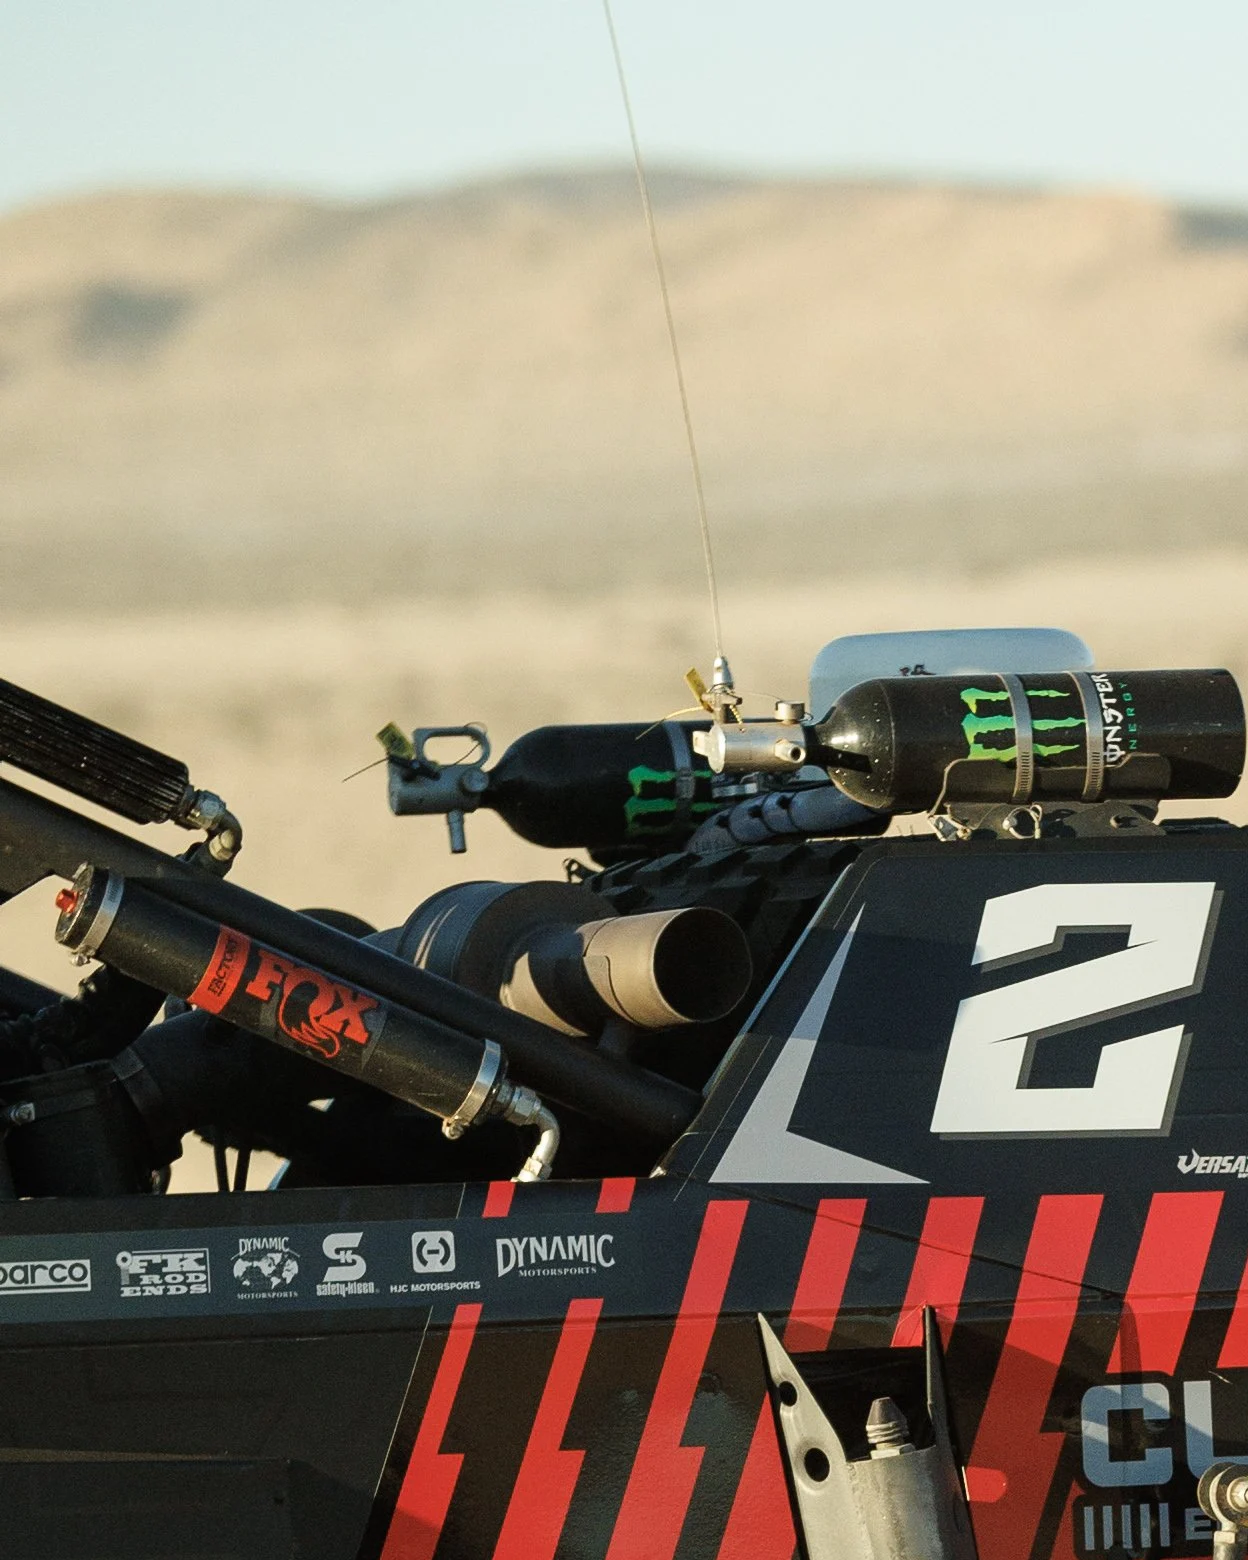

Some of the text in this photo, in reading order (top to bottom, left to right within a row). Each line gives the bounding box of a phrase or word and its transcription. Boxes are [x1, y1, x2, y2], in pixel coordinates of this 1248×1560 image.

[1091, 673, 1125, 764] ONSTER
[246, 948, 379, 1058] FOX
[931, 881, 1222, 1136] 2
[238, 1236, 290, 1256] DYNAMIC
[495, 1234, 616, 1278] DYNAMIC
[129, 1252, 206, 1274] FK
[518, 1266, 597, 1278] MOTORSPORTS
[140, 1273, 207, 1284] ROD
[390, 1280, 481, 1294] HJC MOTORSPORTS
[120, 1283, 208, 1297] ENDS
[236, 1290, 299, 1300] MOTORSPORTS
